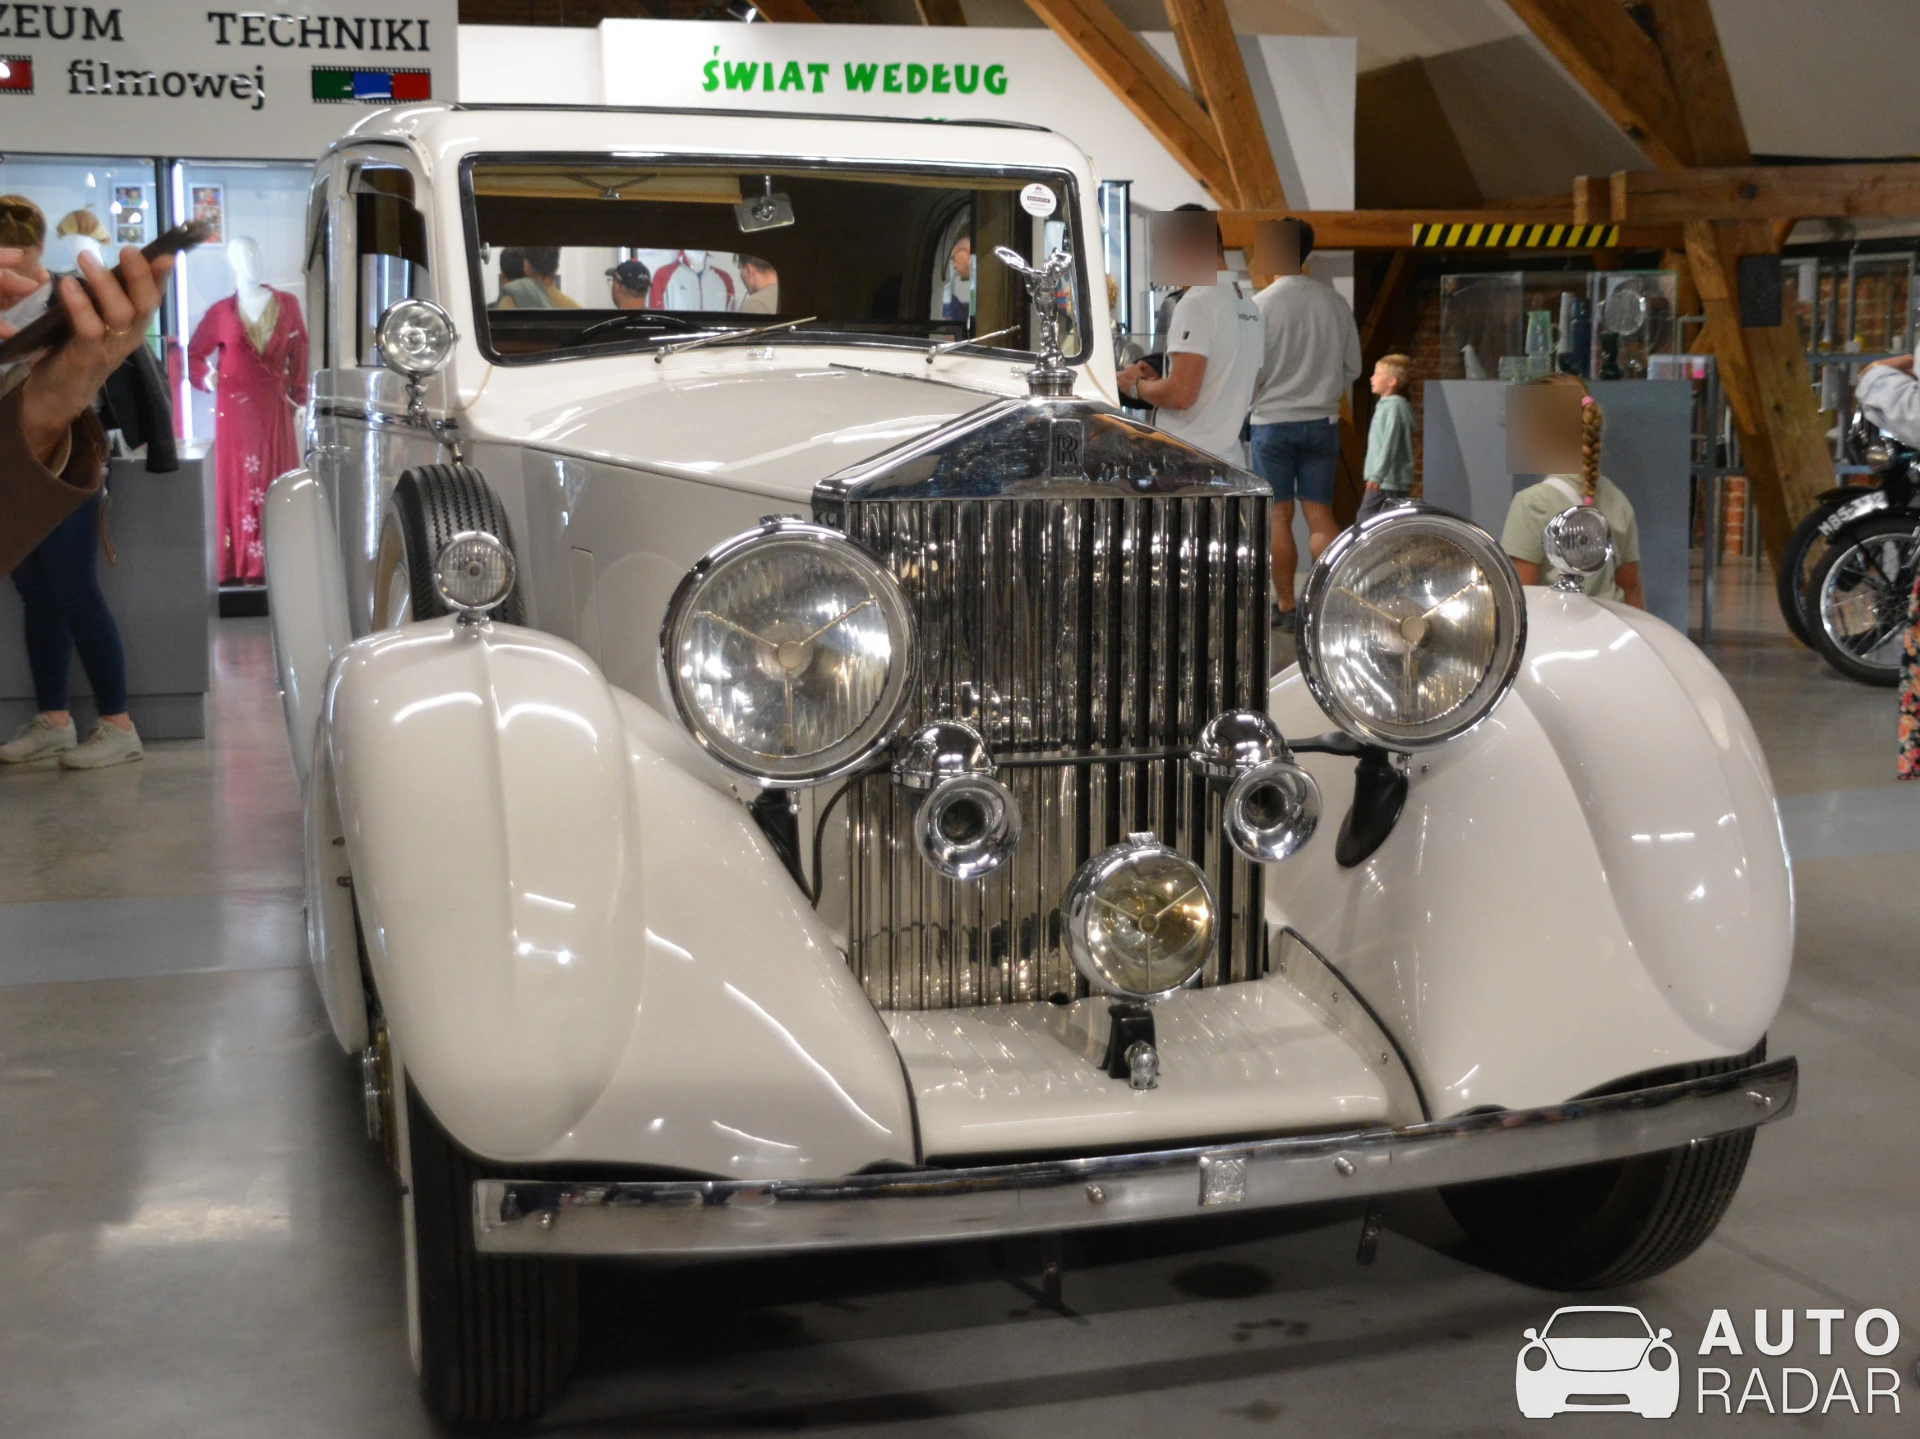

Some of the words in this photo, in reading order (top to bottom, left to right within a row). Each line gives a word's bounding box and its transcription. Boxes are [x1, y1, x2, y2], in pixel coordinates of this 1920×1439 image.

[207, 12, 431, 51] TECHNIKI
[68, 59, 266, 111] filmowej
[702, 45, 829, 94] ŚWIAT
[844, 62, 1008, 96] WEDŁUG
